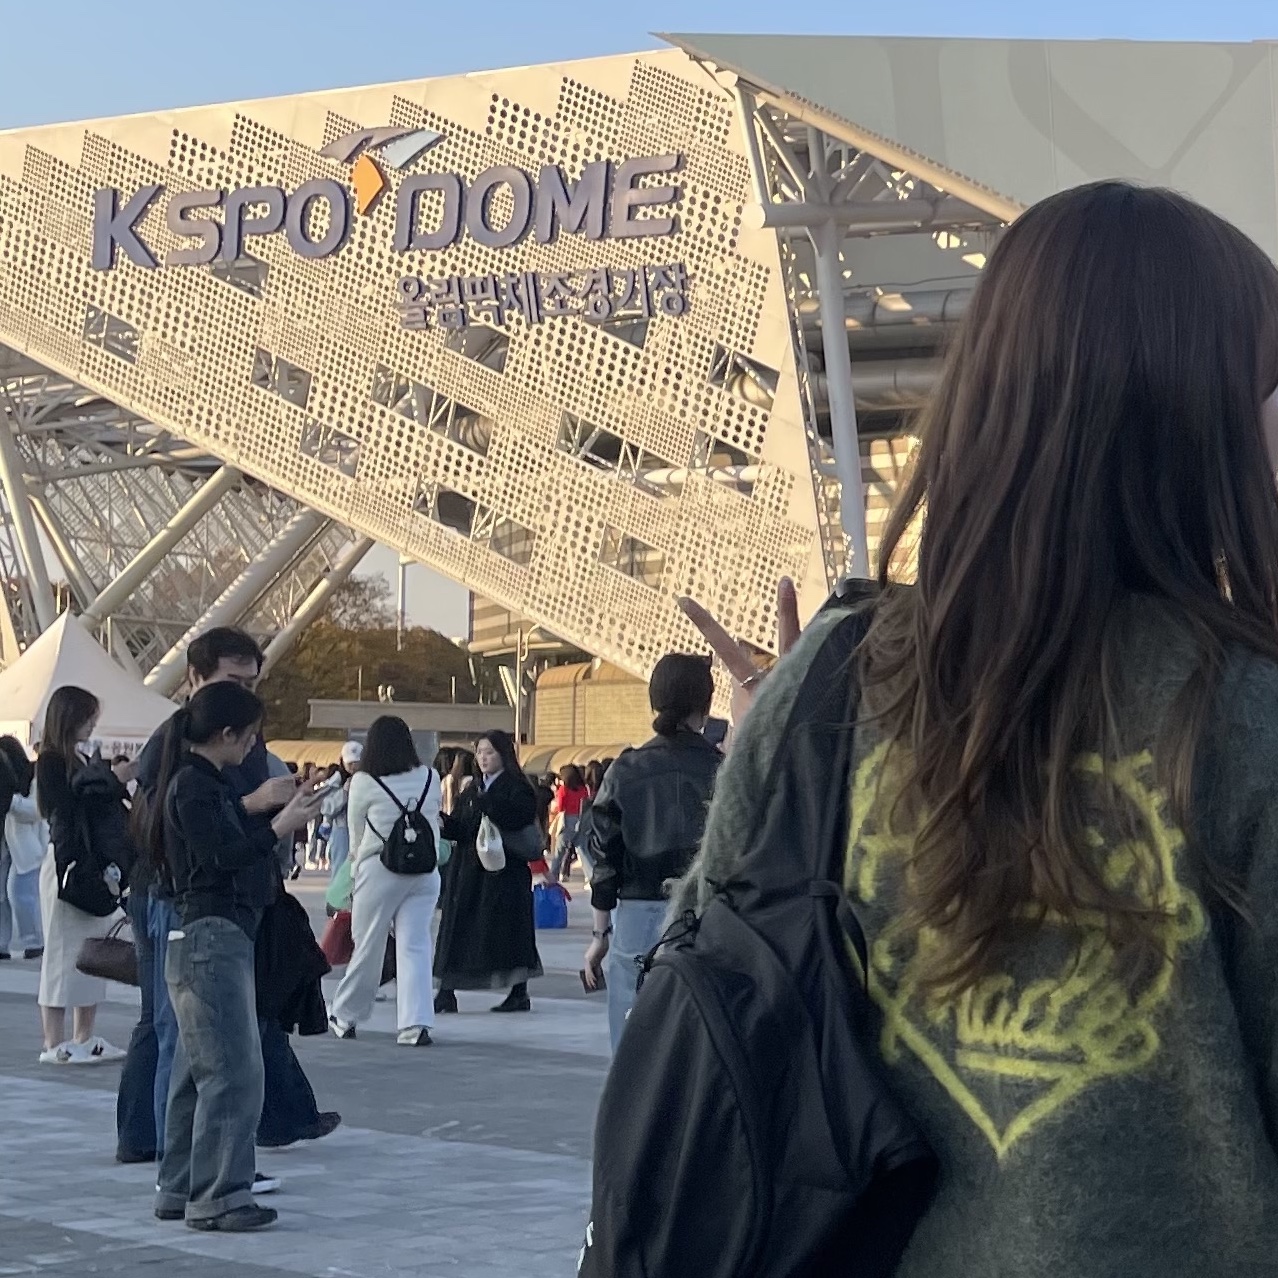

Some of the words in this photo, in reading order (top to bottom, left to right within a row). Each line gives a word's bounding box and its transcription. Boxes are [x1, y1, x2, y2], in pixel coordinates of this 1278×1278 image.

[91, 177, 350, 271] KSPO
[396, 153, 688, 253] DOME
[396, 262, 693, 331] 올림픽체조경기장
